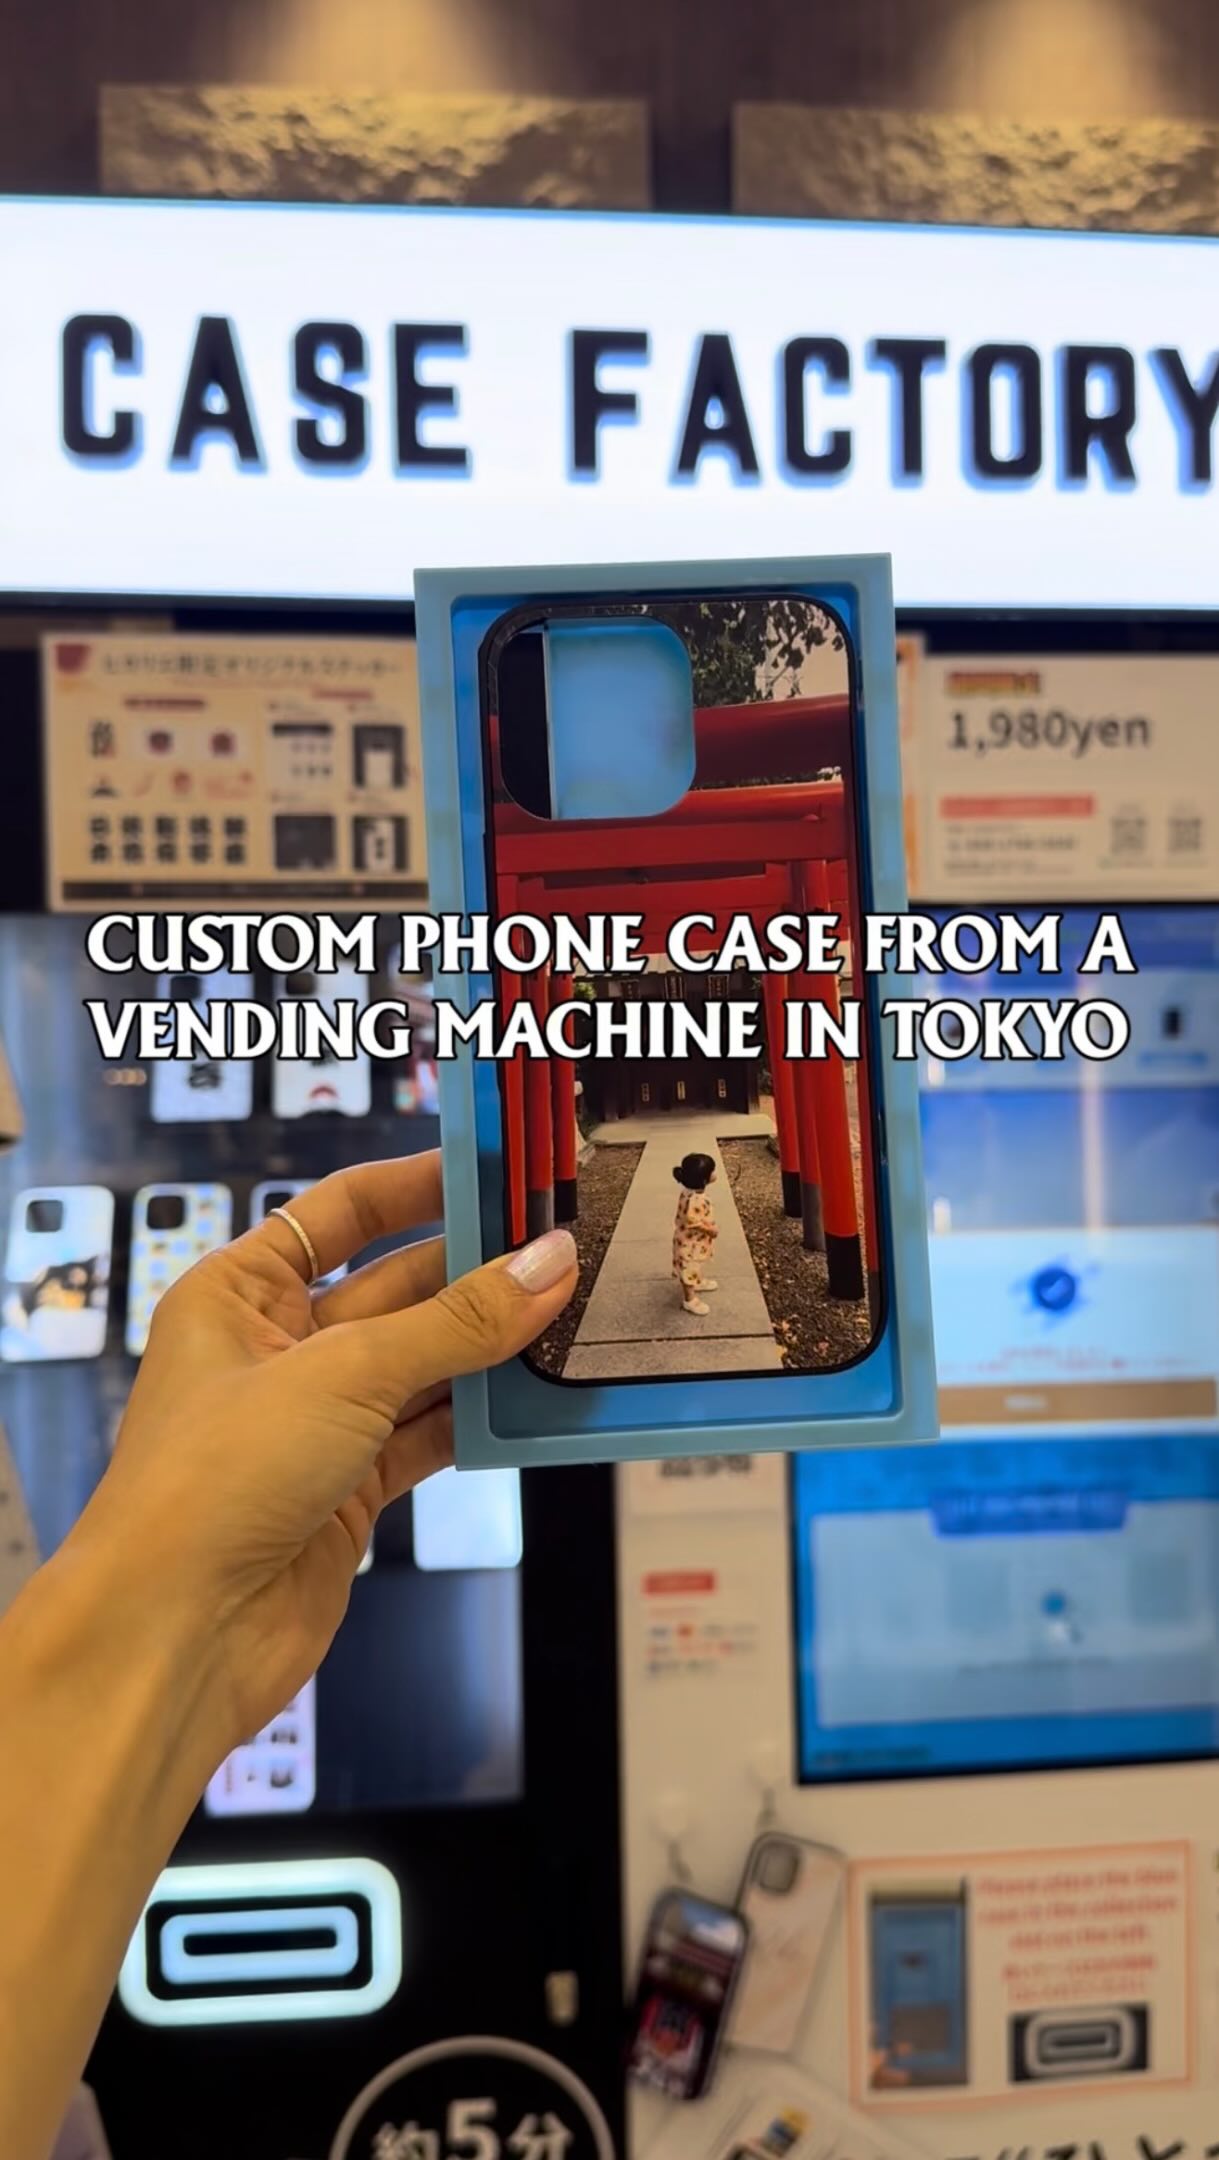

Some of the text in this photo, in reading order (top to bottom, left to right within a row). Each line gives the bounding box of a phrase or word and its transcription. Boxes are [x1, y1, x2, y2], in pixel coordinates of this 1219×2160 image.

[61, 312, 1219, 494] CASE FACTORY
[946, 710, 1152, 758] 1,980yen
